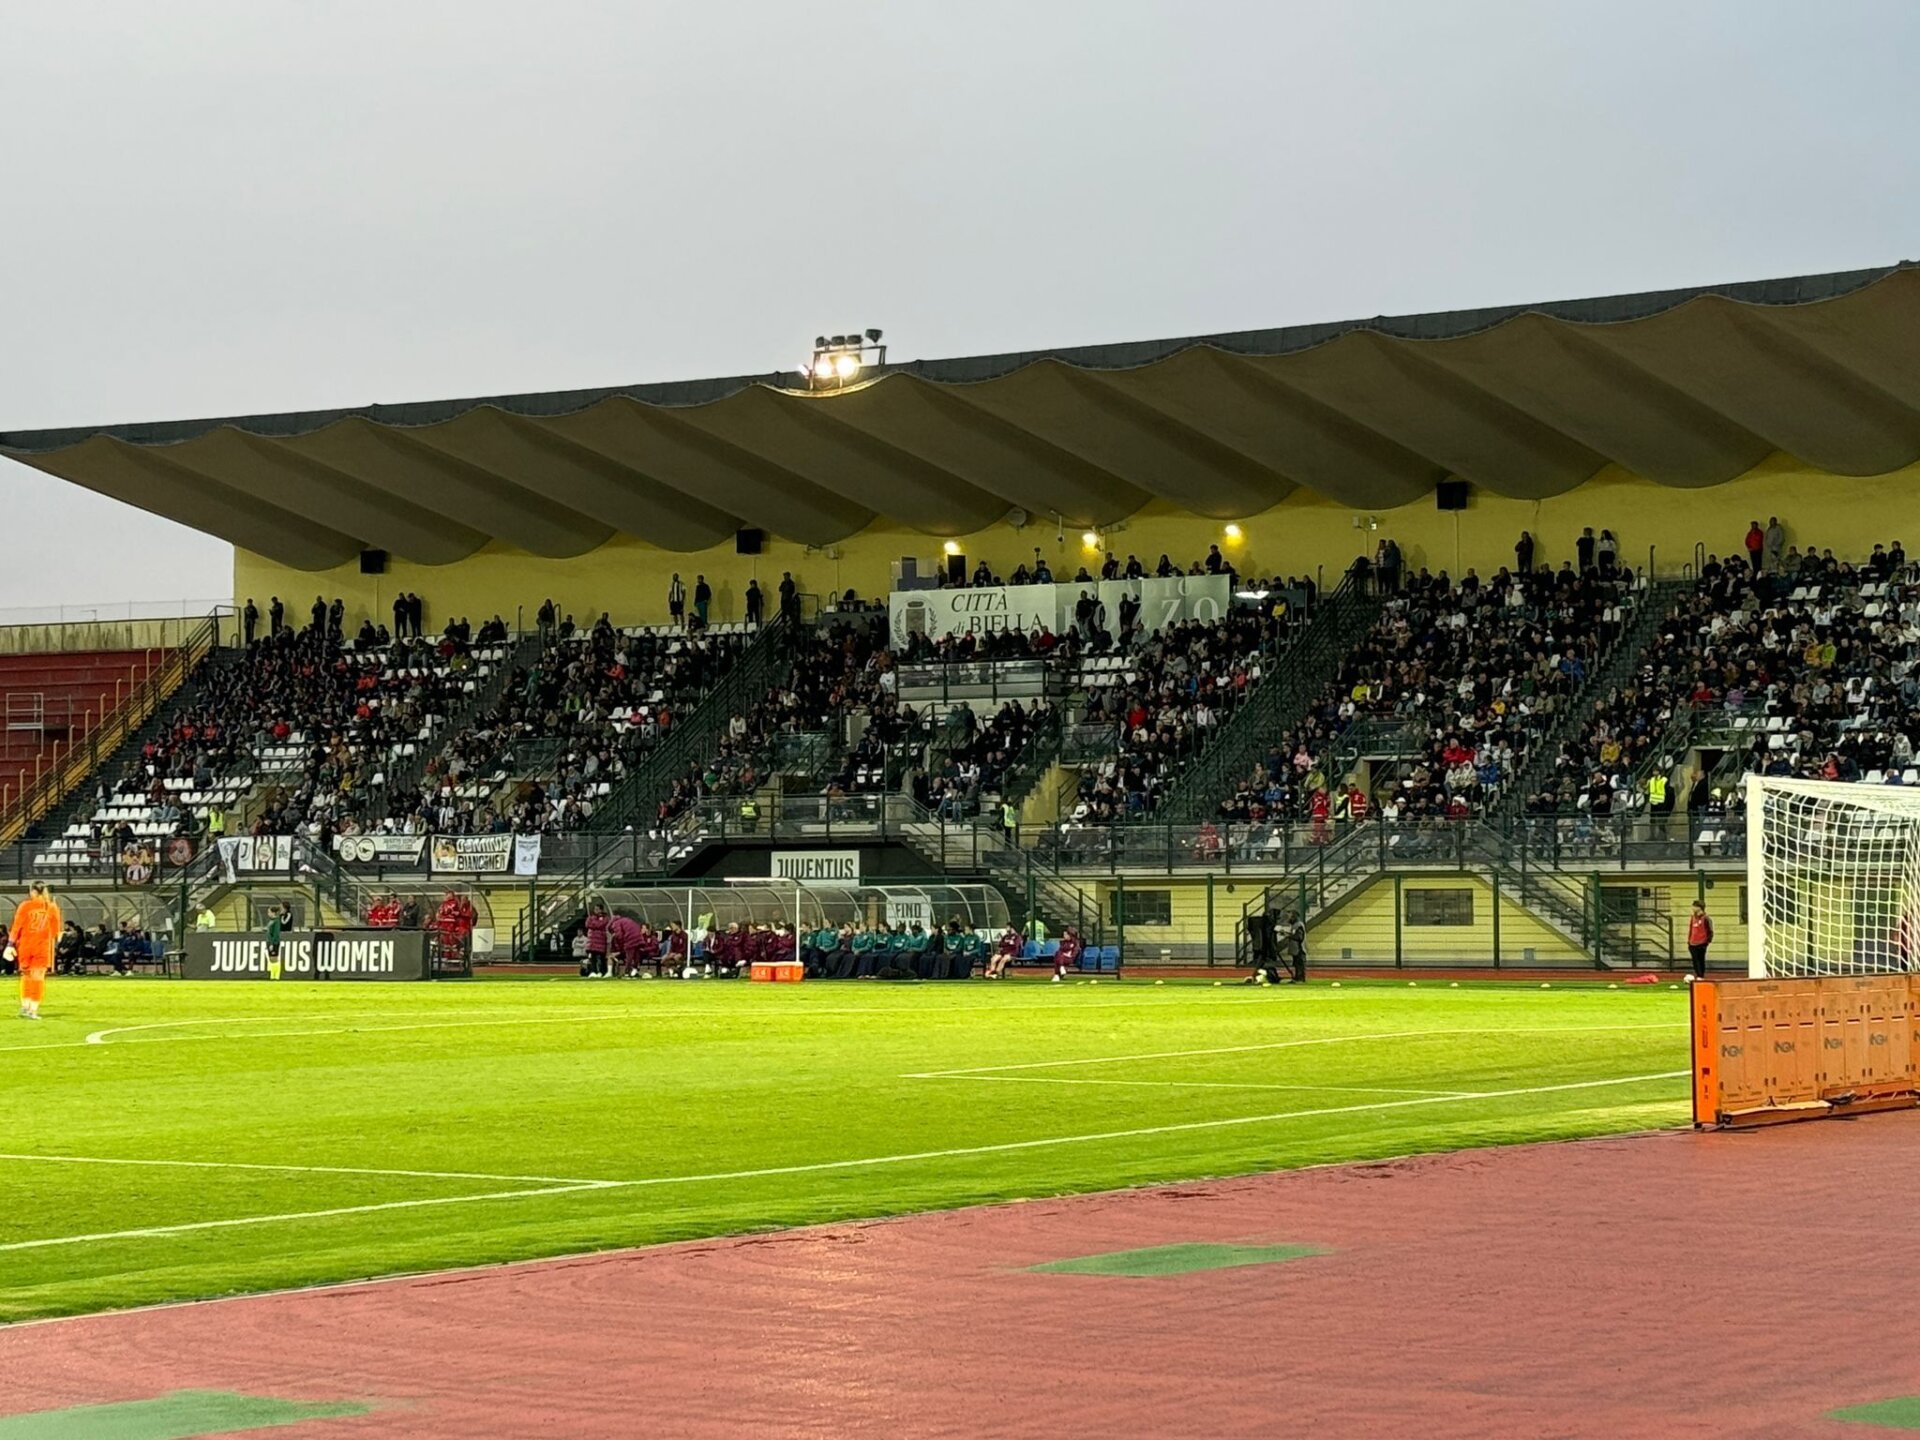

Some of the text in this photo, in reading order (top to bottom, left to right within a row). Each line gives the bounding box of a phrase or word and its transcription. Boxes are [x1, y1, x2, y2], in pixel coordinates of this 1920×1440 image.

[951, 588, 1008, 613] CITTÀ
[953, 613, 1045, 635] di BIELLA
[777, 858, 854, 879] JUVENTUS
[210, 940, 395, 972] JUVENUS WOMEN
